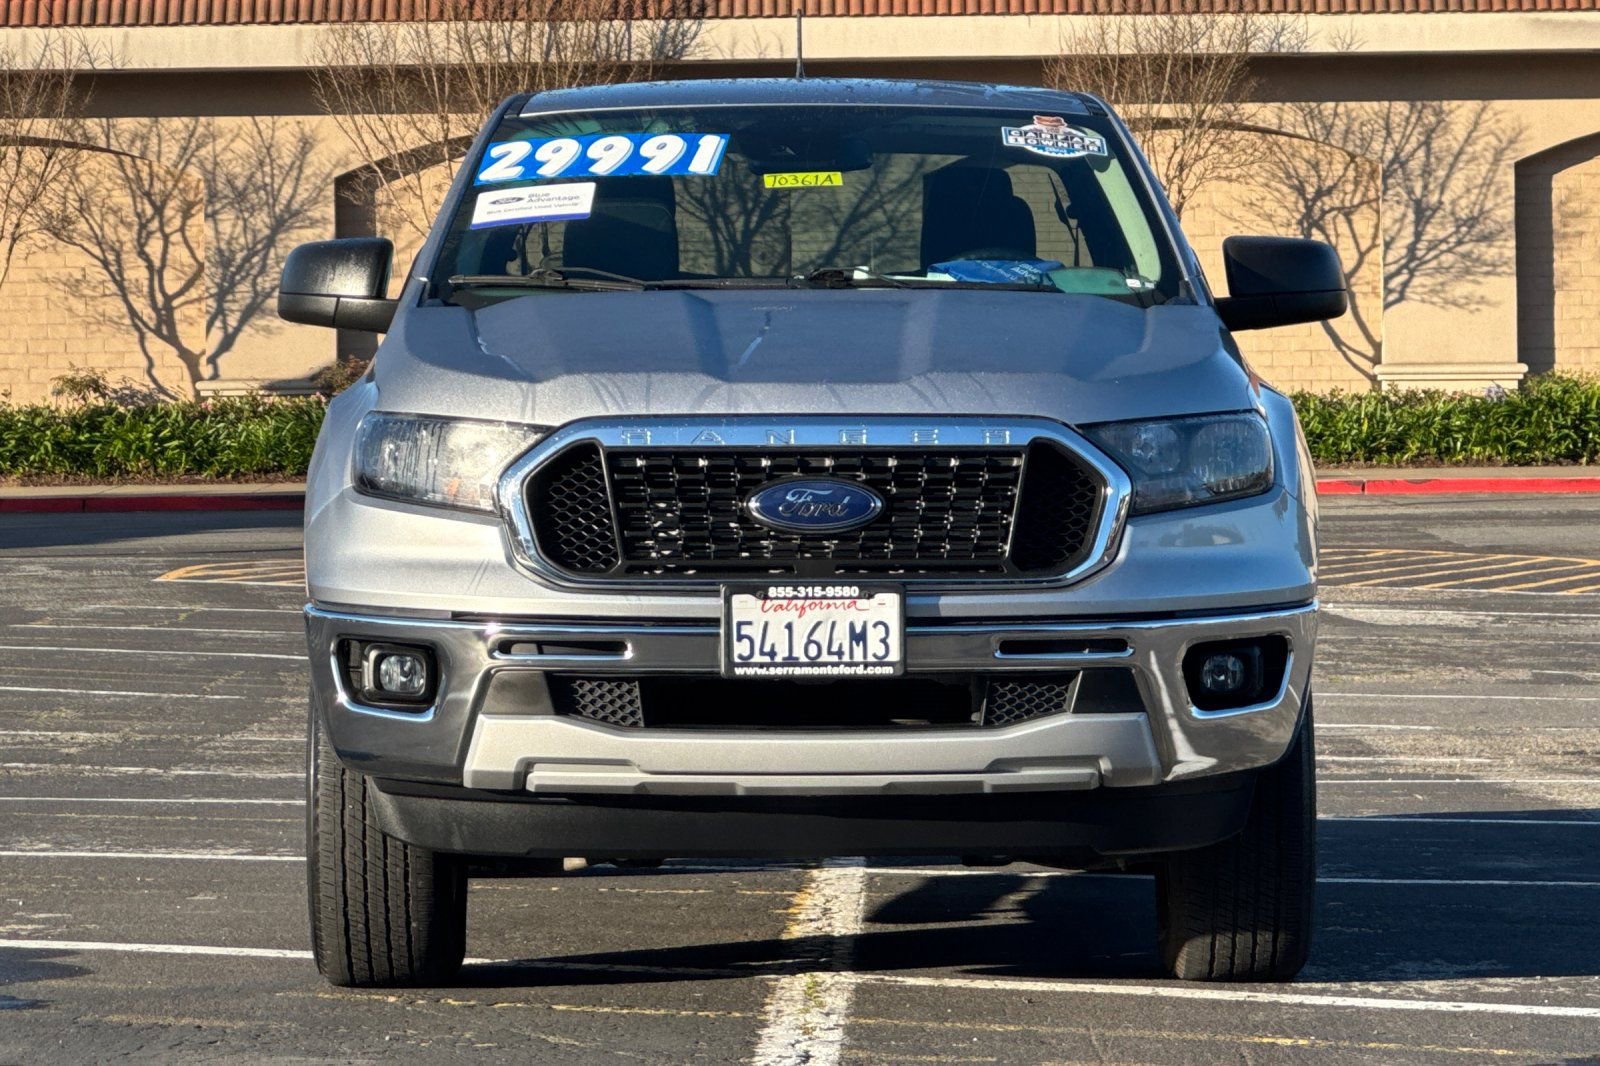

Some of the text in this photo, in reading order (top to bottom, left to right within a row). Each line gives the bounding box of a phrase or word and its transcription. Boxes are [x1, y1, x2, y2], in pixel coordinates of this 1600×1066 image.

[1010, 129, 1101, 146] CARFAX
[1026, 138, 1100, 152] OWNER
[478, 134, 726, 182] 29991
[779, 488, 851, 517] Ford
[767, 586, 860, 598] 855-315-9580
[761, 598, 870, 618] California
[735, 620, 891, 662] 54164M3
[734, 664, 894, 676] www.serramonteford.com
